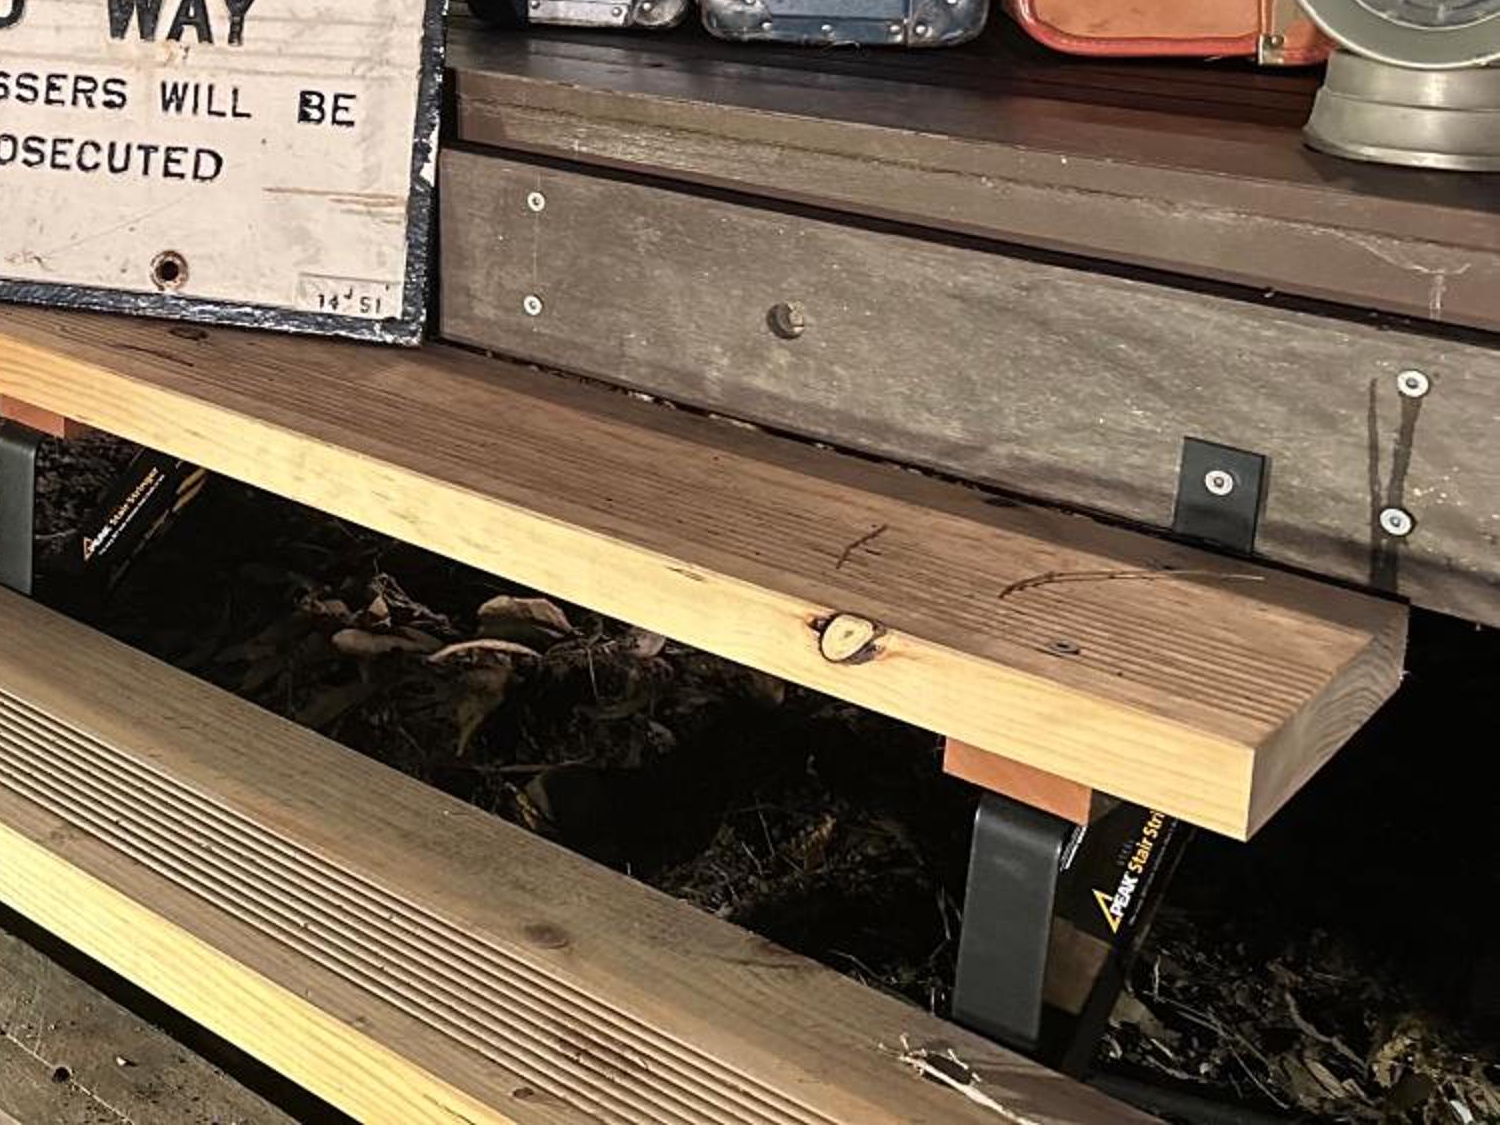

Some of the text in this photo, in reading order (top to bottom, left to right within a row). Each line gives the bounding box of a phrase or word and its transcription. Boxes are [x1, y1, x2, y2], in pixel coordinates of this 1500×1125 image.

[161, 81, 252, 118] WILL
[298, 90, 356, 127] BE
[1109, 871, 1139, 918] PEAK
[1126, 838, 1154, 874] Stair
